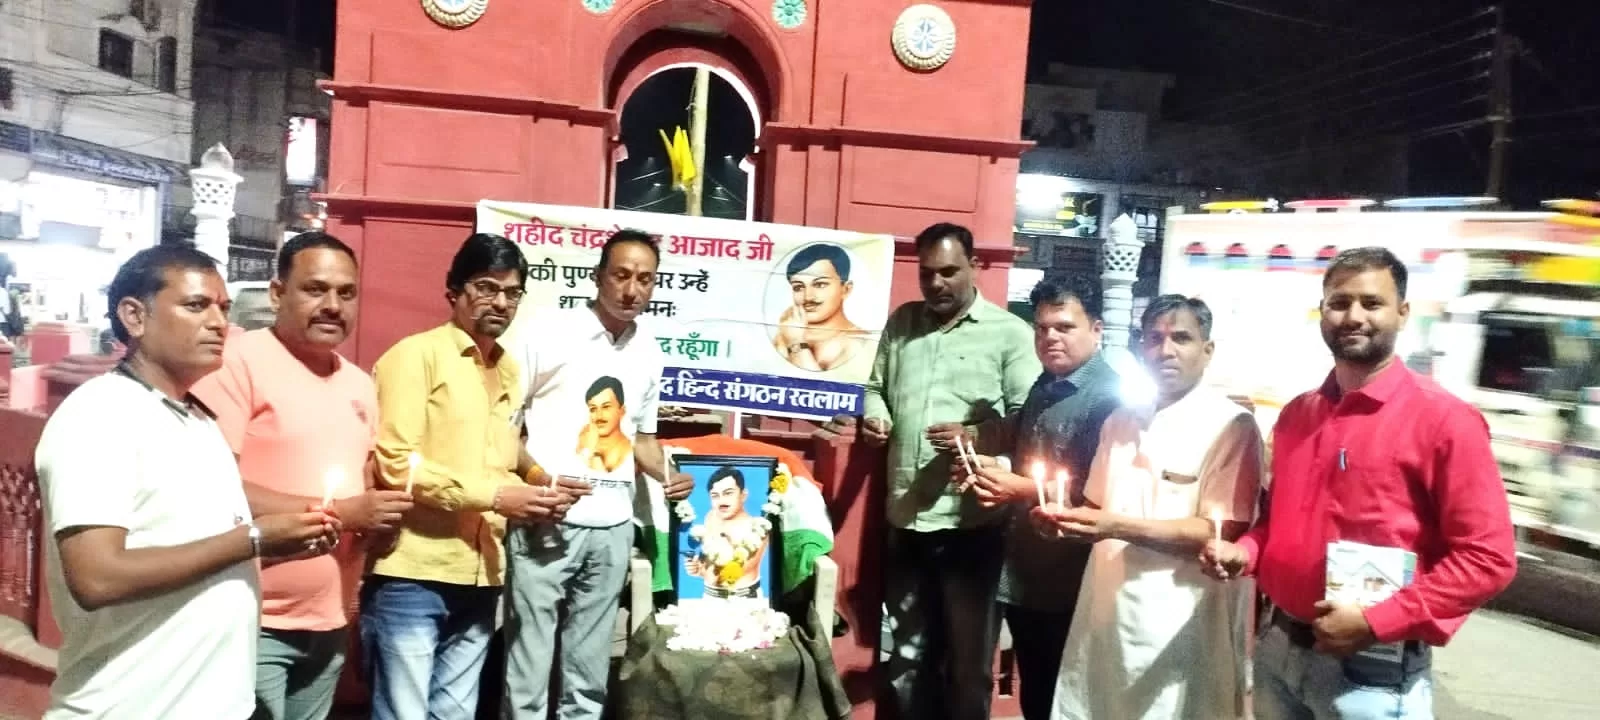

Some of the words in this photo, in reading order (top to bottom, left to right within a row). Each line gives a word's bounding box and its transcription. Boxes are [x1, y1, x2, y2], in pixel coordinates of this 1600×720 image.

[503, 216, 565, 248] शहीद
[667, 234, 742, 260] आजाद
[746, 233, 775, 261] जी
[677, 269, 711, 293] उन्हें
[638, 300, 677, 317] मनः
[676, 332, 720, 360] रहूँगा
[675, 369, 721, 400] हिन्द
[722, 377, 787, 406] संगठन
[788, 386, 859, 412] रतलाम
